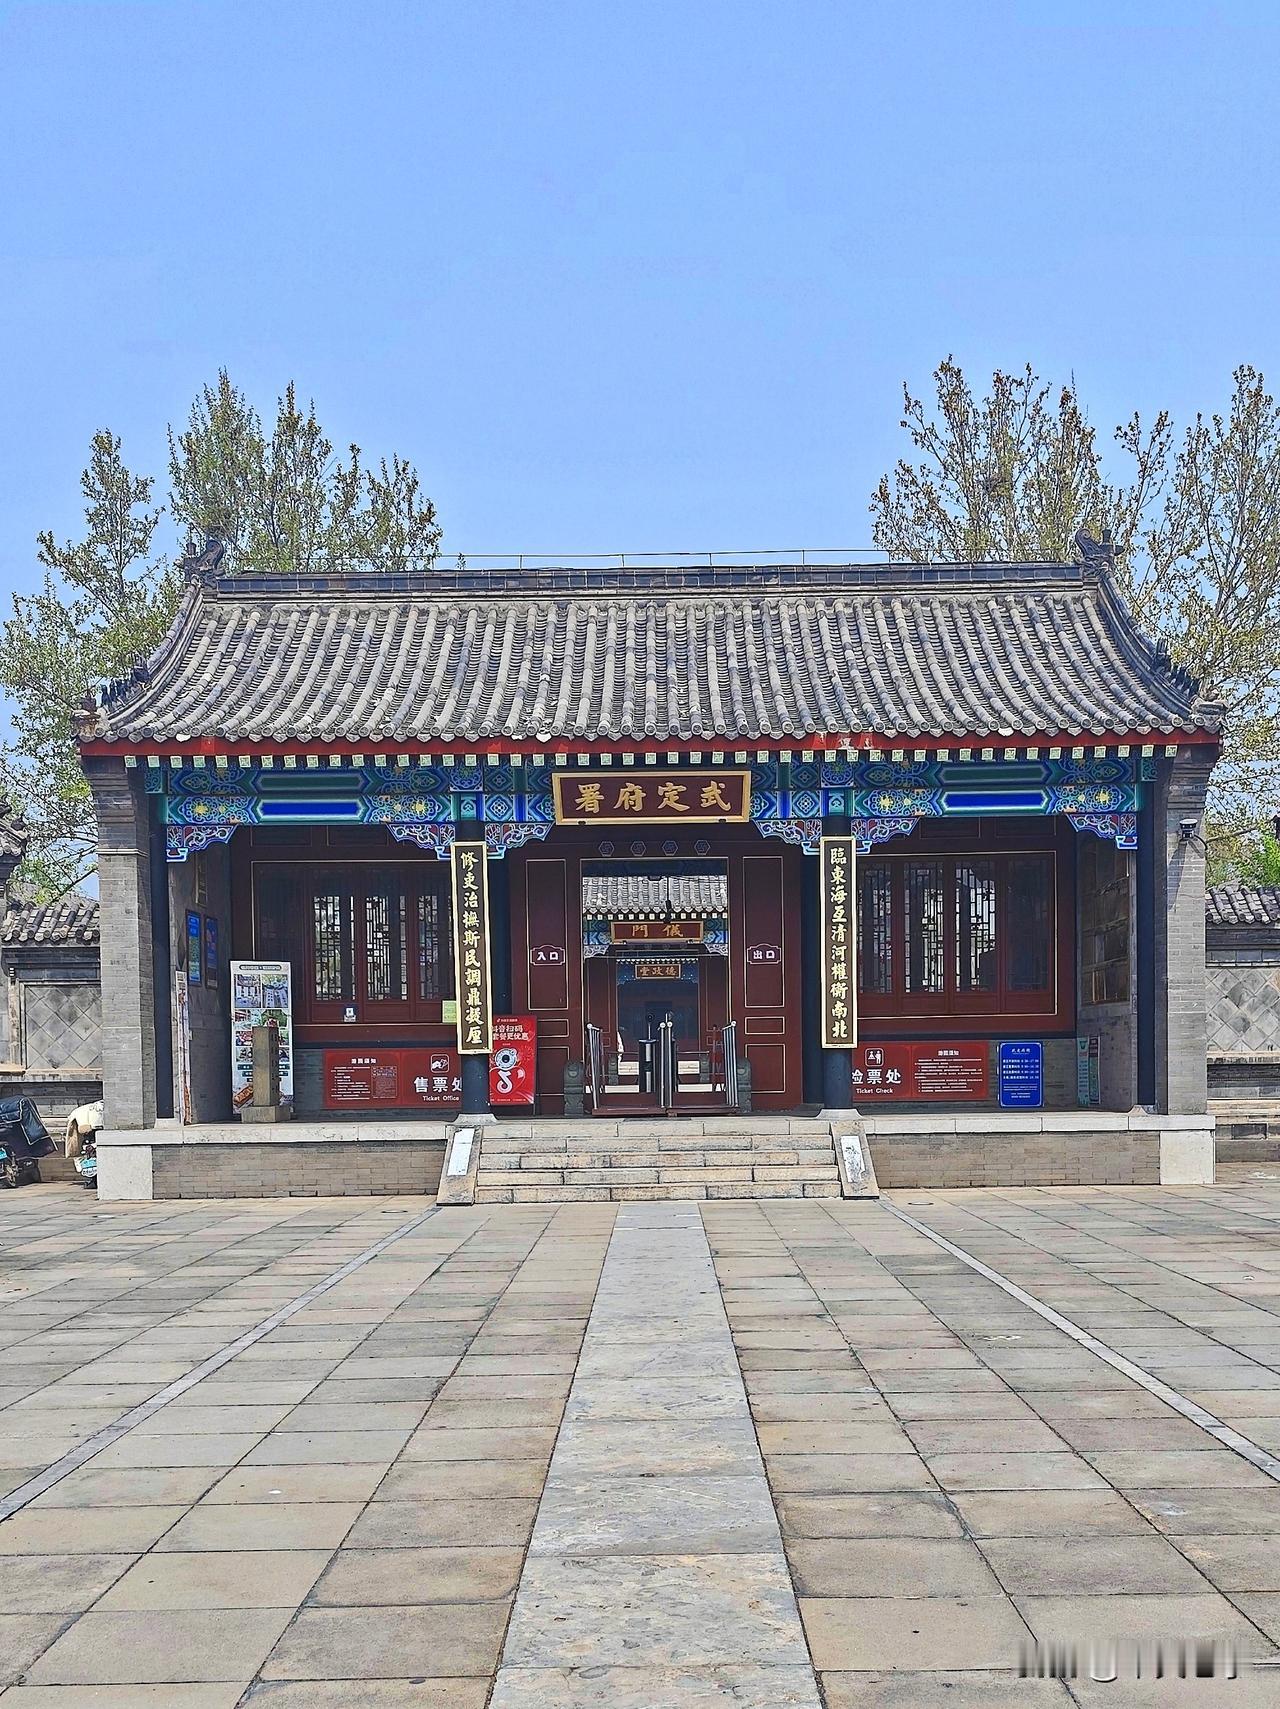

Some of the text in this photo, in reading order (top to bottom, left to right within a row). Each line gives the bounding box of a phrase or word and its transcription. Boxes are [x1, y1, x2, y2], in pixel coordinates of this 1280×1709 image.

[574, 780, 732, 814] 武定府署
[632, 924, 684, 938] 儀門
[536, 951, 559, 961] 入口
[753, 950, 775, 960] 出口
